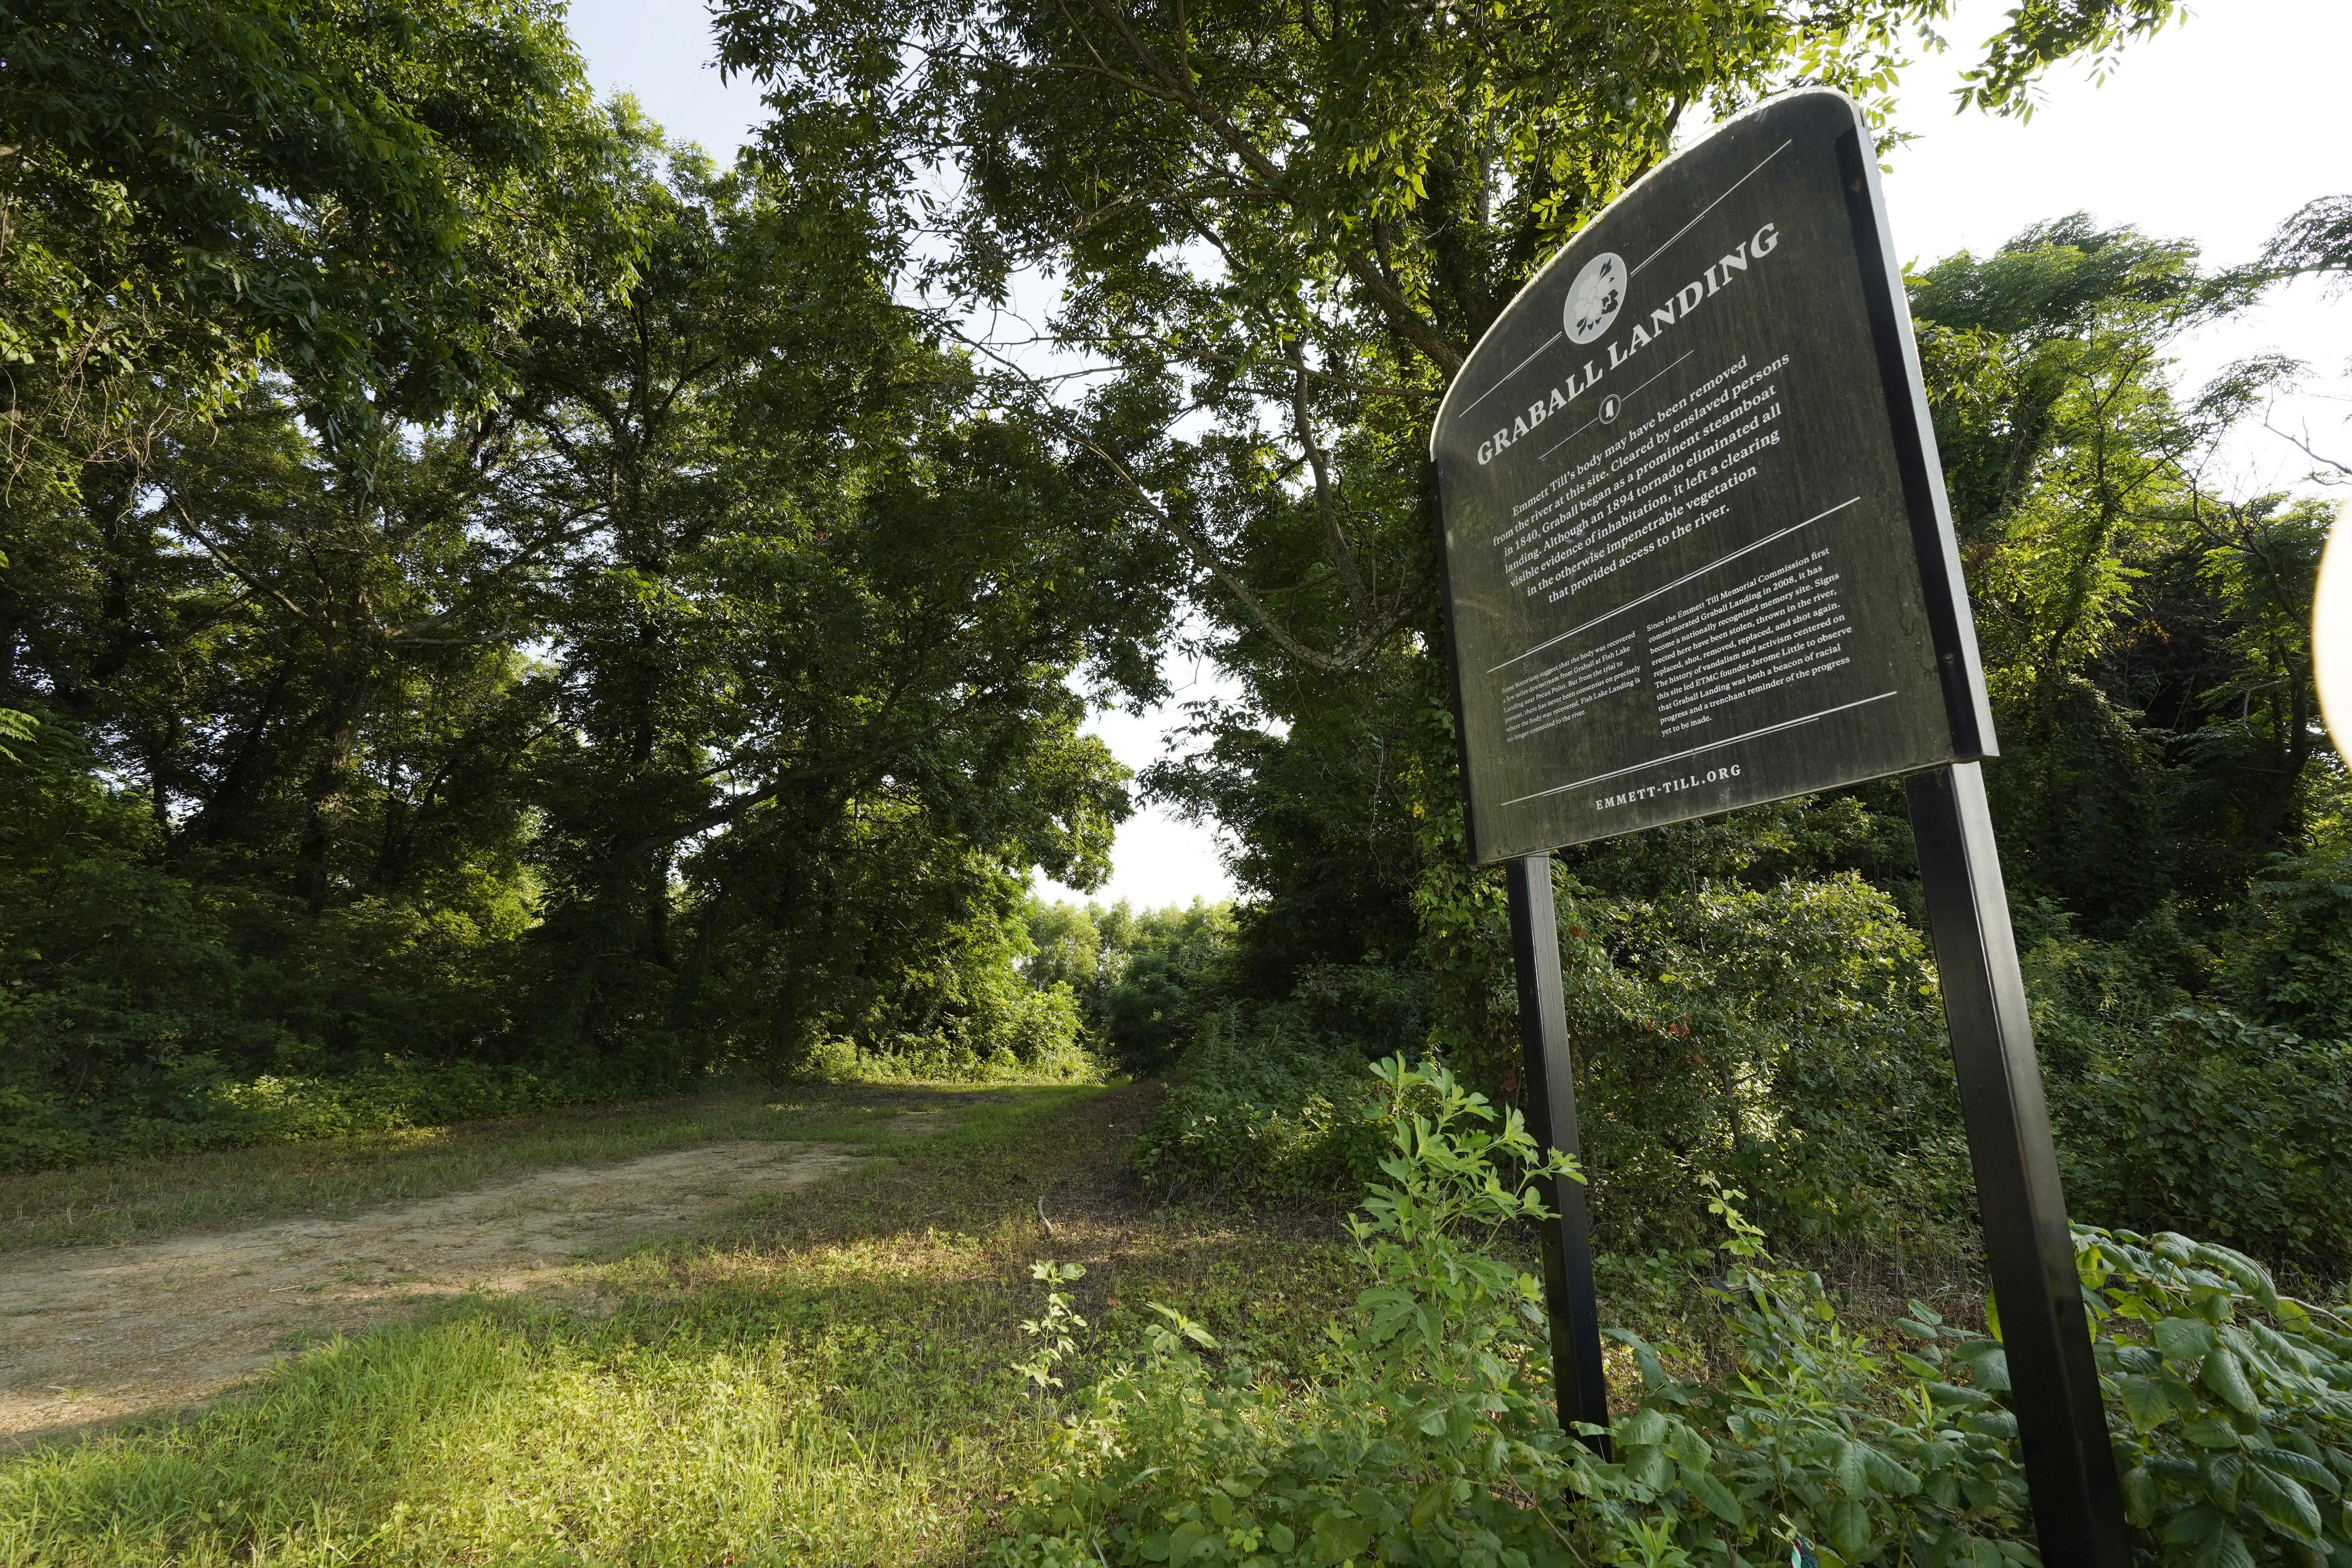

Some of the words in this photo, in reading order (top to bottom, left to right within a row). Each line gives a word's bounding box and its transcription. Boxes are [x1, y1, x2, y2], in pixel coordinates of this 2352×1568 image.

[1477, 360, 1603, 465] GRABALL
[1607, 223, 1779, 370] LANDING
[1493, 529, 1514, 547] from
[1514, 519, 1530, 533] the
[1530, 503, 1553, 523] river
[1555, 496, 1565, 508] at
[1565, 484, 1585, 501] this
[1587, 471, 1609, 488] site.
[1611, 436, 1655, 472] Cleared
[1655, 428, 1671, 444] by
[1673, 388, 1730, 433] enslaved
[1731, 354, 1789, 400] persons
[1504, 546, 1514, 557] in
[1515, 529, 1541, 551] 1840,
[1542, 504, 1579, 533] Graball
[1579, 487, 1612, 511] began
[1613, 478, 1625, 491] as
[1627, 473, 1635, 483] a
[1635, 431, 1701, 481] prominent
[1703, 385, 1776, 437] steamboat
[1512, 488, 1549, 517] Emmett
[1576, 453, 1602, 475] body
[1604, 437, 1627, 458] may
[1628, 419, 1656, 442] have
[1657, 398, 1688, 423] been
[1689, 354, 1748, 402] removed
[1504, 548, 1542, 574] landing.
[1543, 518, 1589, 552] Although
[1591, 511, 1604, 524] an
[1606, 490, 1635, 515] 1894
[1636, 464, 1684, 497] tornado
[1686, 415, 1760, 468] eliminated
[1762, 402, 1782, 423] all
[1510, 566, 1539, 587] visible
[1541, 542, 1583, 571] evidence
[1585, 531, 1596, 546] of
[1597, 494, 1671, 540] inhabitation,
[1673, 484, 1684, 497] it
[1685, 469, 1708, 490] left
[1710, 465, 1719, 476] a
[1720, 430, 1780, 469] clearing
[1527, 586, 1537, 597] in
[1538, 577, 1554, 590] the
[1555, 549, 1605, 581] otherwise
[1606, 506, 1684, 555] impenetrable
[1685, 466, 1757, 510] vegetation
[1548, 586, 1569, 603] that
[1570, 559, 1617, 595] provided
[1619, 543, 1655, 568] access
[1656, 535, 1670, 547] to
[1671, 523, 1692, 540] the
[1694, 504, 1730, 528] river.
[1646, 620, 1665, 632] Since
[1665, 615, 1677, 624] the
[1677, 602, 1705, 619] Emmett
[1705, 594, 1719, 606] Till
[1720, 578, 1757, 600] Memorial
[1758, 557, 1810, 583] Commission
[1811, 548, 1830, 561] first
[1648, 615, 1700, 643] commemorated
[1700, 603, 1728, 621] Graball
[1728, 591, 1762, 610] Landing
[1772, 575, 1797, 591] 2008,
[1798, 572, 1806, 580] it
[1806, 565, 1823, 577] has
[1650, 640, 1675, 654] become
[1681, 622, 1717, 642] nationally
[1718, 604, 1759, 627] recognized
[1760, 591, 1793, 610] memory
[1795, 584, 1813, 595] site.
[1814, 573, 1840, 587] Signs
[1651, 650, 1676, 666] erected
[1676, 646, 1692, 656] here
[1692, 639, 1710, 650] have
[1710, 632, 1728, 642] been
[1729, 622, 1755, 635] stolen,
[1756, 609, 1786, 624] thrown
[1787, 604, 1797, 613] in
[1797, 598, 1812, 608] the
[1813, 589, 1837, 603] river,
[1501, 685, 1515, 694] Some
[1514, 674, 1539, 688] historians
[1539, 665, 1559, 678] suggest
[1559, 660, 1570, 669] that
[1580, 650, 1594, 660] body
[1594, 645, 1606, 653] was
[1606, 630, 1636, 649] recovered
[1653, 661, 1684, 677] replaced,
[1684, 655, 1702, 666] shot,
[1703, 640, 1737, 659] removed,
[1738, 626, 1774, 645] replaced,
[1775, 618, 1791, 631] and
[1792, 612, 1811, 624] shot
[1813, 603, 1840, 617] again.
[1654, 680, 1668, 689] The
[1668, 670, 1693, 684] history
[1694, 665, 1702, 674] of
[1702, 653, 1740, 671] vandalism
[1741, 645, 1757, 657] and
[1757, 634, 1792, 651] activism
[1793, 617, 1831, 638] centered
[1833, 615, 1845, 623] on
[1656, 691, 1670, 701] this
[1670, 687, 1683, 696] site
[1683, 681, 1695, 691] led
[1695, 672, 1719, 687] ETMC
[1720, 663, 1749, 678] founder
[1750, 652, 1780, 667] Jerome
[1781, 642, 1805, 656] Little
[1817, 626, 1852, 644] observe
[1658, 702, 1672, 712] that
[1673, 692, 1699, 707] Graball
[1699, 683, 1731, 698] Landing
[1731, 677, 1746, 687] was
[1746, 670, 1766, 682] both
[1773, 658, 1804, 673] beacon
[1804, 652, 1814, 662] of
[1815, 643, 1841, 659] racial
[1504, 701, 1524, 713] Landing
[1524, 697, 1535, 705] near
[1535, 690, 1551, 700] Pecan
[1551, 684, 1568, 694] Point.
[1568, 679, 1578, 687] But
[1579, 673, 1592, 683] from
[1603, 662, 1616, 673] trial
[1505, 712, 1524, 724] present,
[1524, 706, 1537, 715] there
[1547, 697, 1562, 706] never
[1562, 691, 1575, 701] been
[1576, 680, 1605, 695] consensus
[1613, 665, 1641, 682] precisely
[1660, 710, 1688, 726] progress
[1689, 703, 1703, 714] and
[1709, 691, 1746, 708] trenchant
[1747, 678, 1784, 695] reminder
[1786, 673, 1795, 682] of
[1795, 670, 1810, 679] the
[1811, 657, 1850, 676] progress
[1595, 764, 1741, 810] EMMETT-TILL.ORG
